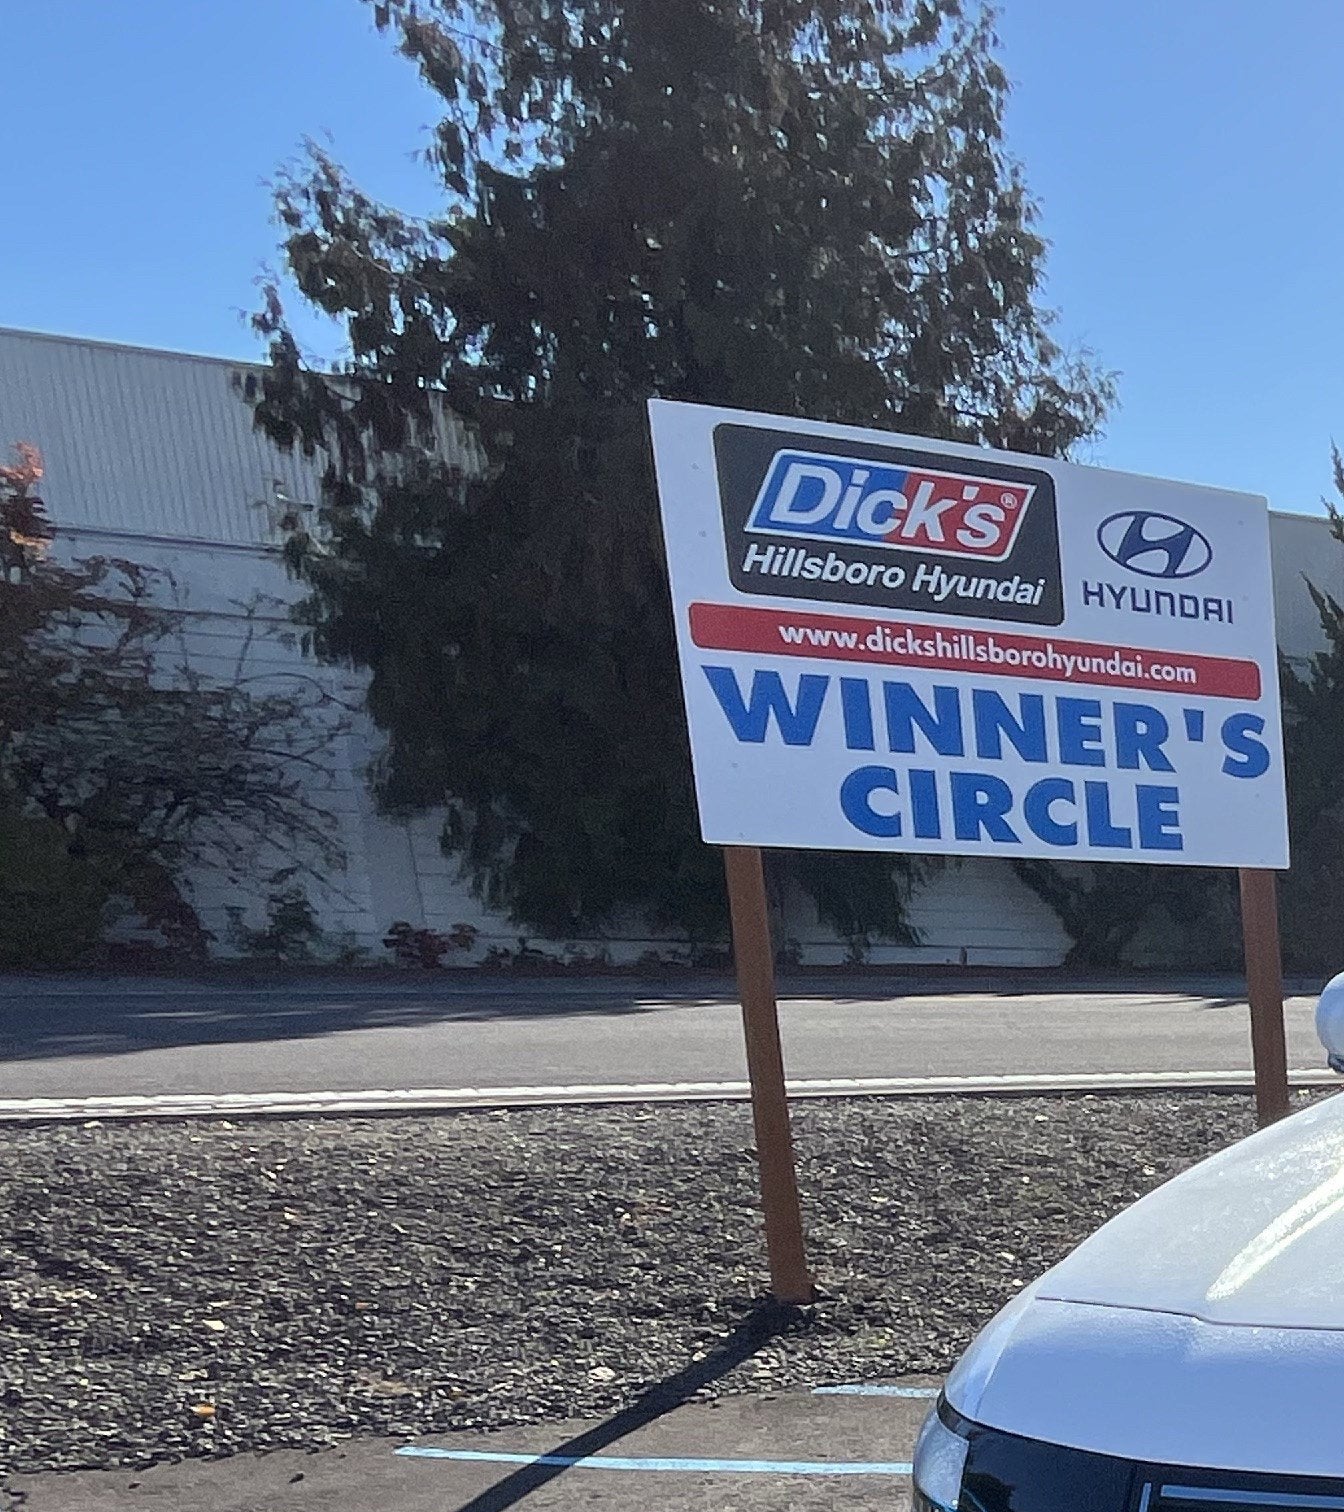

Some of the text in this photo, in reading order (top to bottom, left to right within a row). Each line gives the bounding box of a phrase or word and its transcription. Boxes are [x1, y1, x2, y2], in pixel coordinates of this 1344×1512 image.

[741, 543, 1046, 606] Hillsboro Hyundai
[1082, 580, 1235, 624] HYUNDAI
[778, 621, 1198, 686] www.dickshillsborohyundai.com
[700, 664, 1271, 779] WINNER'S
[839, 764, 1184, 851] CIRCLE
